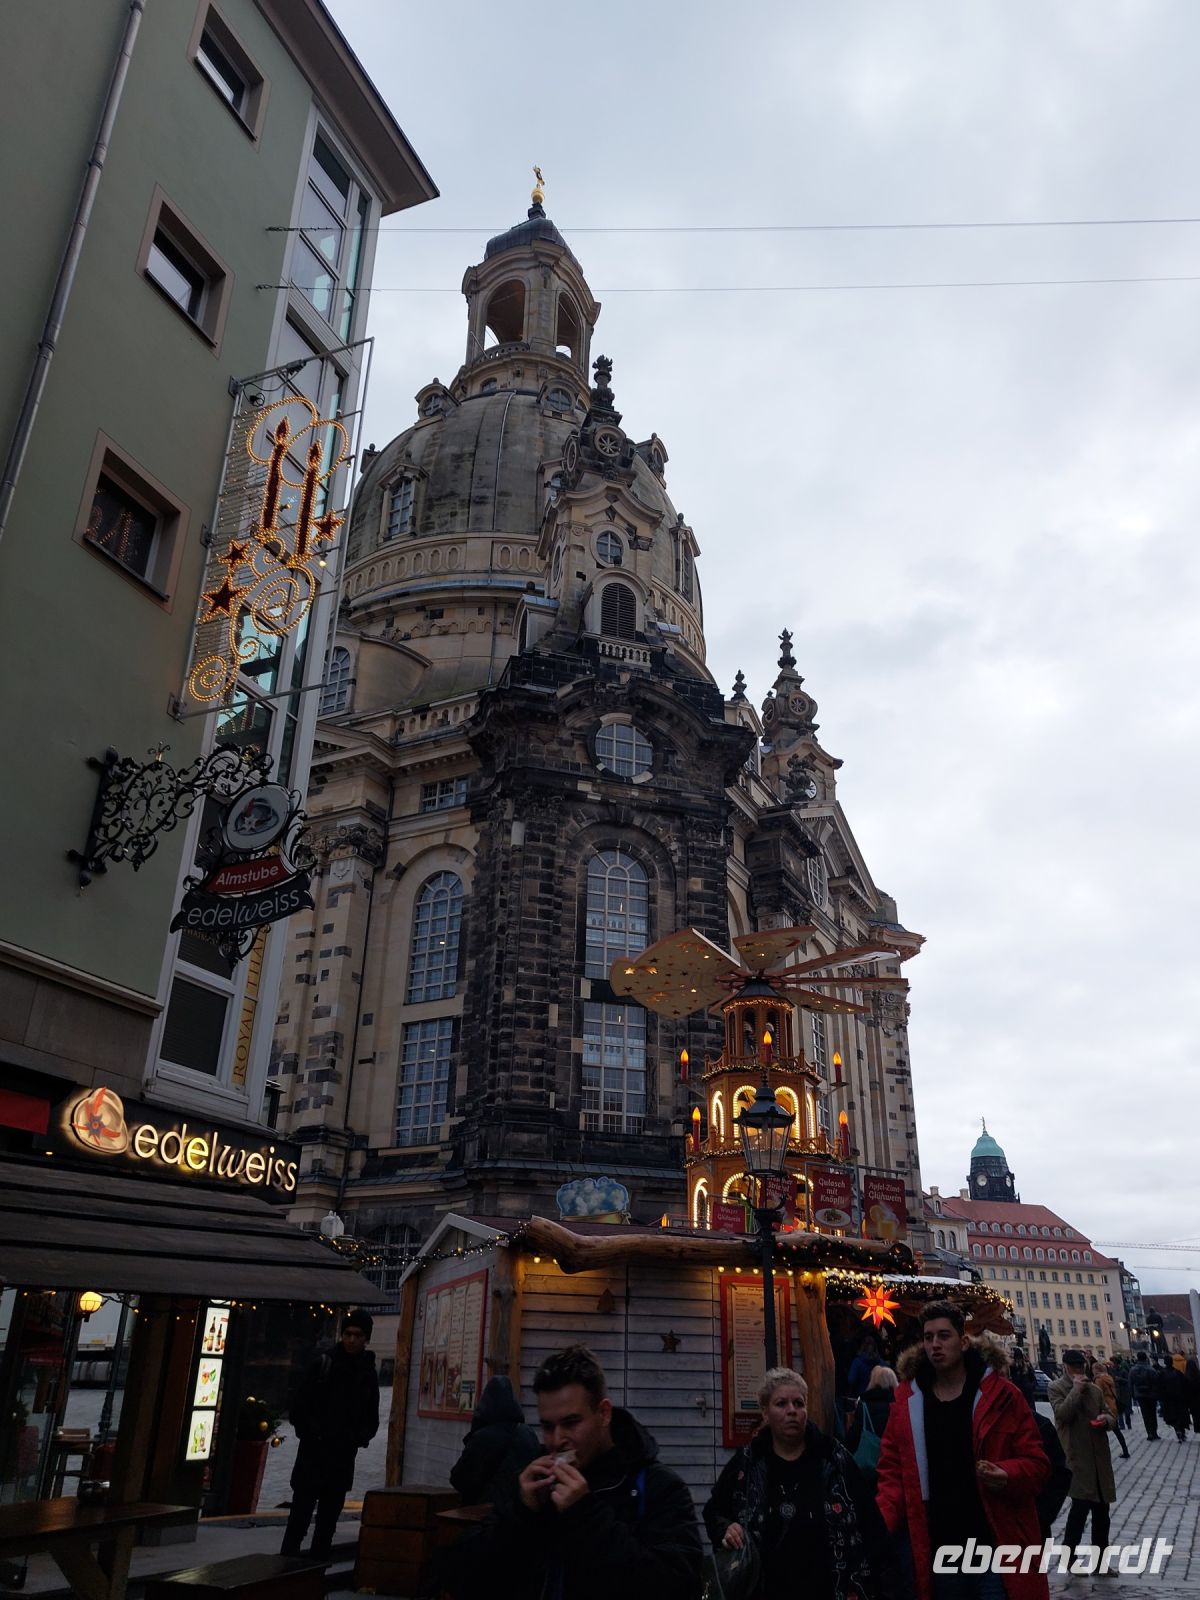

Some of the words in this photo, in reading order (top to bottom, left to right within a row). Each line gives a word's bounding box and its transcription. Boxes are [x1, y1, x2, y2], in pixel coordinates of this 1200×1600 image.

[216, 864, 279, 885] Almstube
[187, 889, 300, 926] edelweiss
[134, 1123, 298, 1192] edelweiss
[818, 1178, 846, 1189] Gulasch
